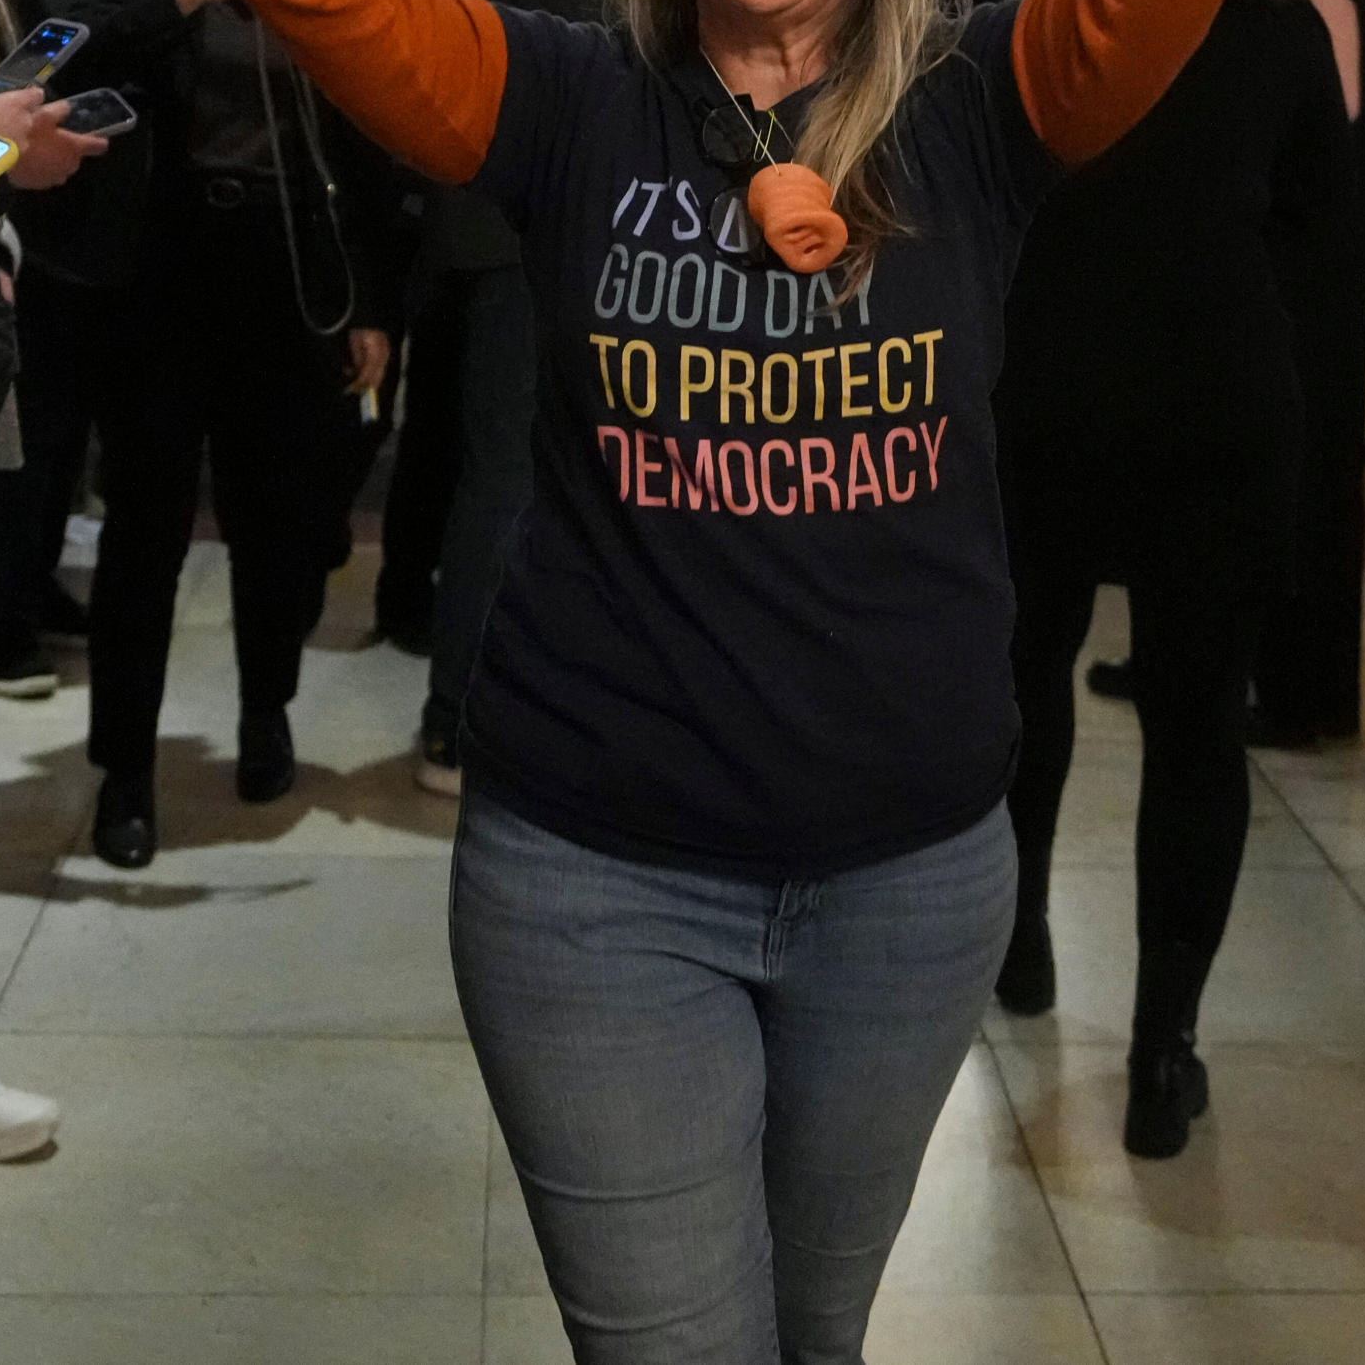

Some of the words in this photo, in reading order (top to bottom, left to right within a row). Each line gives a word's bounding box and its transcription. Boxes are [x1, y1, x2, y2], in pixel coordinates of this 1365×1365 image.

[612, 176, 702, 241] IT'S
[593, 243, 747, 333] GOOD
[765, 255, 874, 338] DAY
[589, 333, 657, 418] TO
[679, 329, 943, 425] PROTECT
[597, 416, 948, 517] DEMOCRACY
